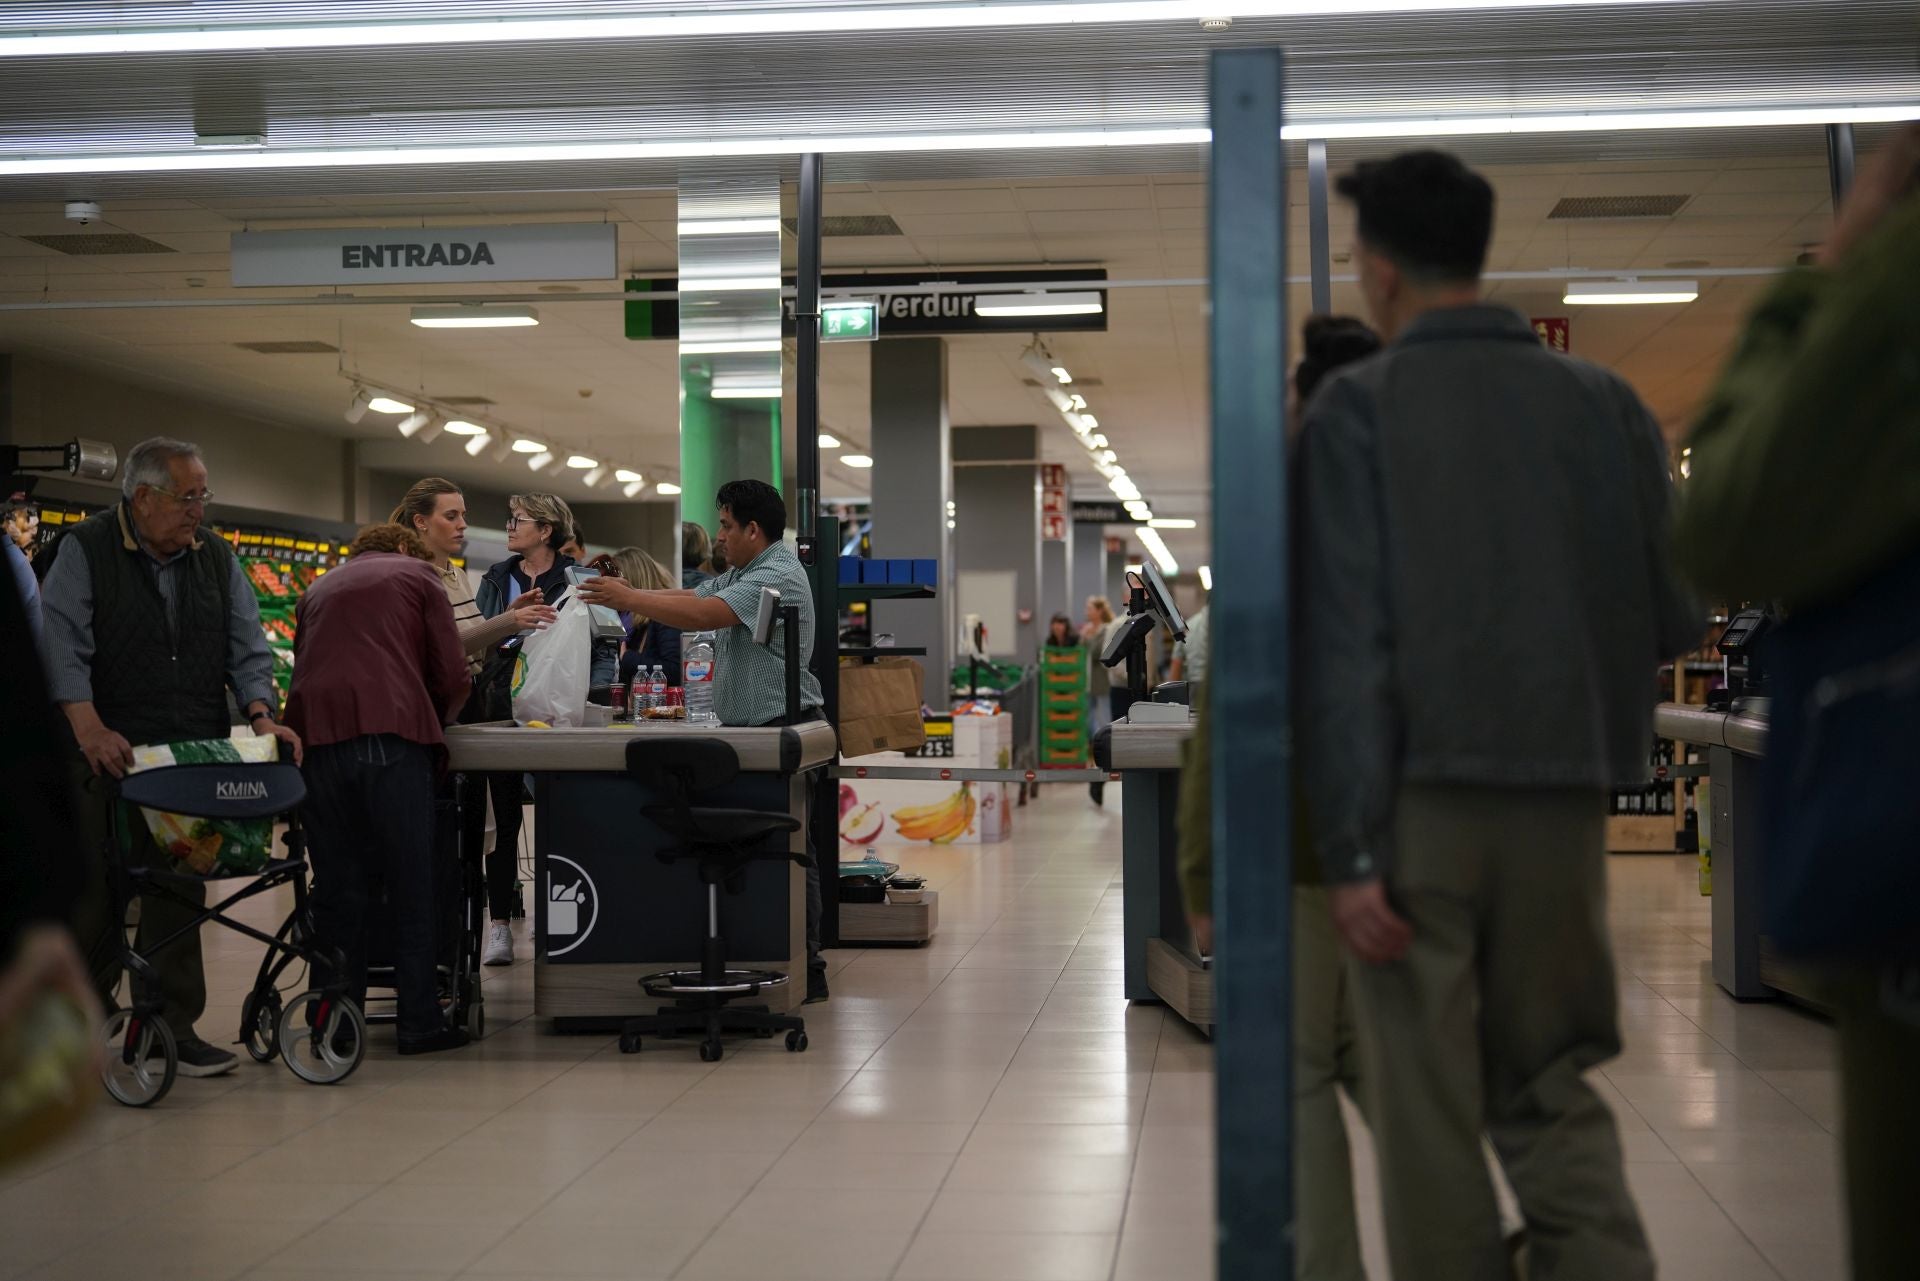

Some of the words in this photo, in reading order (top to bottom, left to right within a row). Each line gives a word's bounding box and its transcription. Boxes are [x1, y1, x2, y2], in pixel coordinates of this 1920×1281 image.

[342, 242, 494, 269] ENTRADA
[879, 293, 975, 319] Verdur
[216, 781, 268, 799] KMINA
